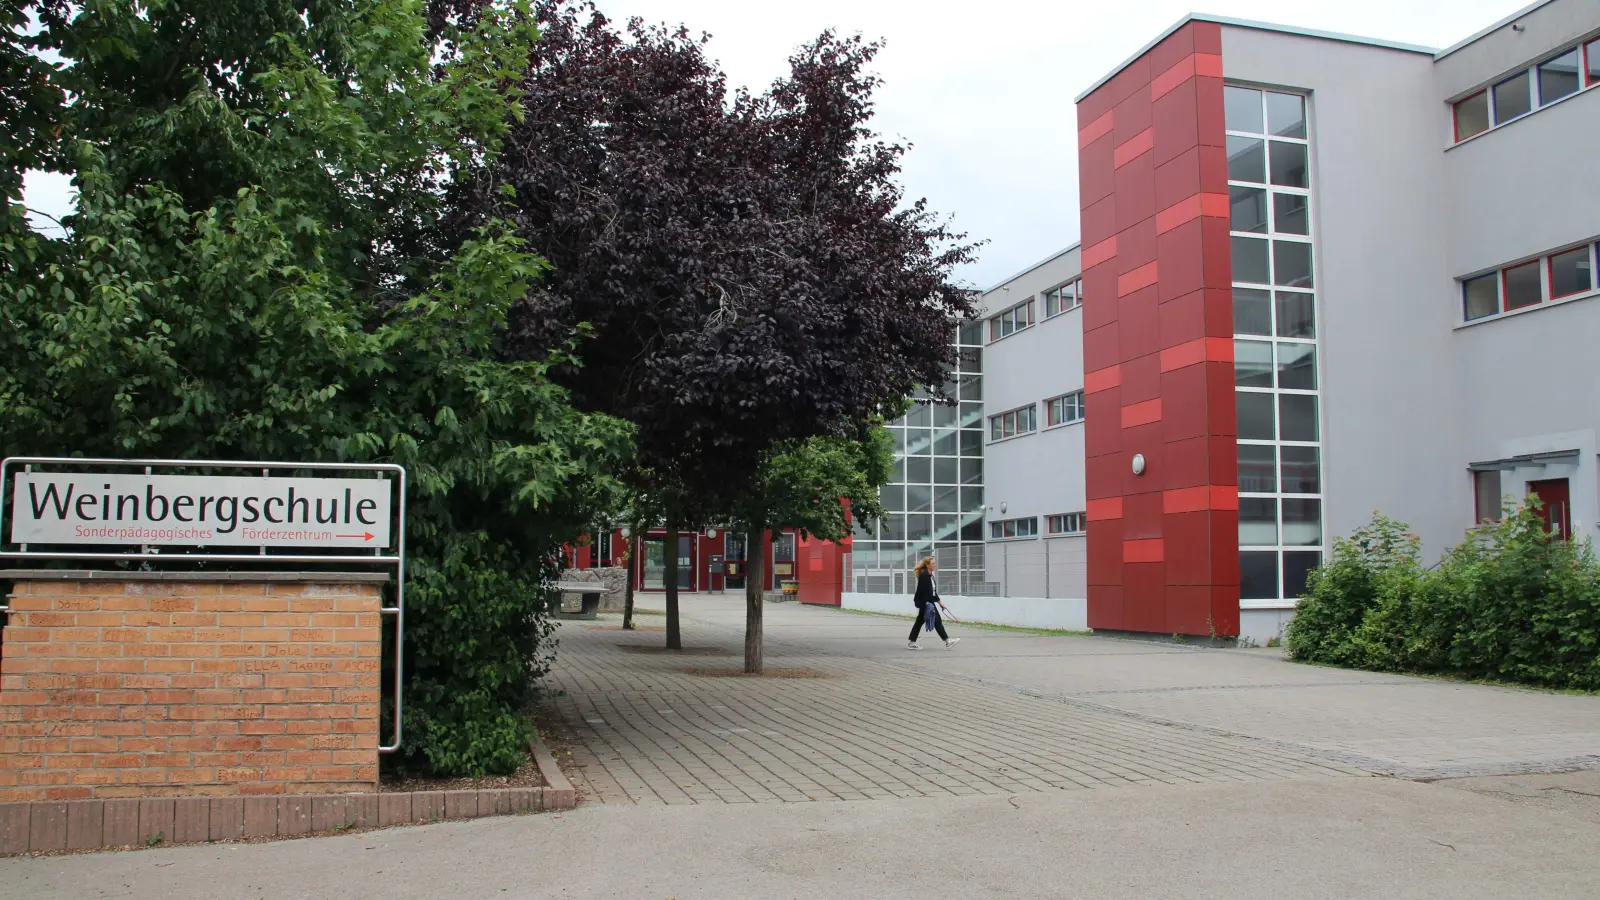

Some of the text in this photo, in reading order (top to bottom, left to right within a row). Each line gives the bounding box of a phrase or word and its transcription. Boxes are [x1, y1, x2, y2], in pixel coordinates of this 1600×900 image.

[29, 482, 376, 533] Weinbergschule
[75, 525, 332, 541] Sonderpädagogisches Förderzentrum
[245, 660, 280, 672] ELLA
